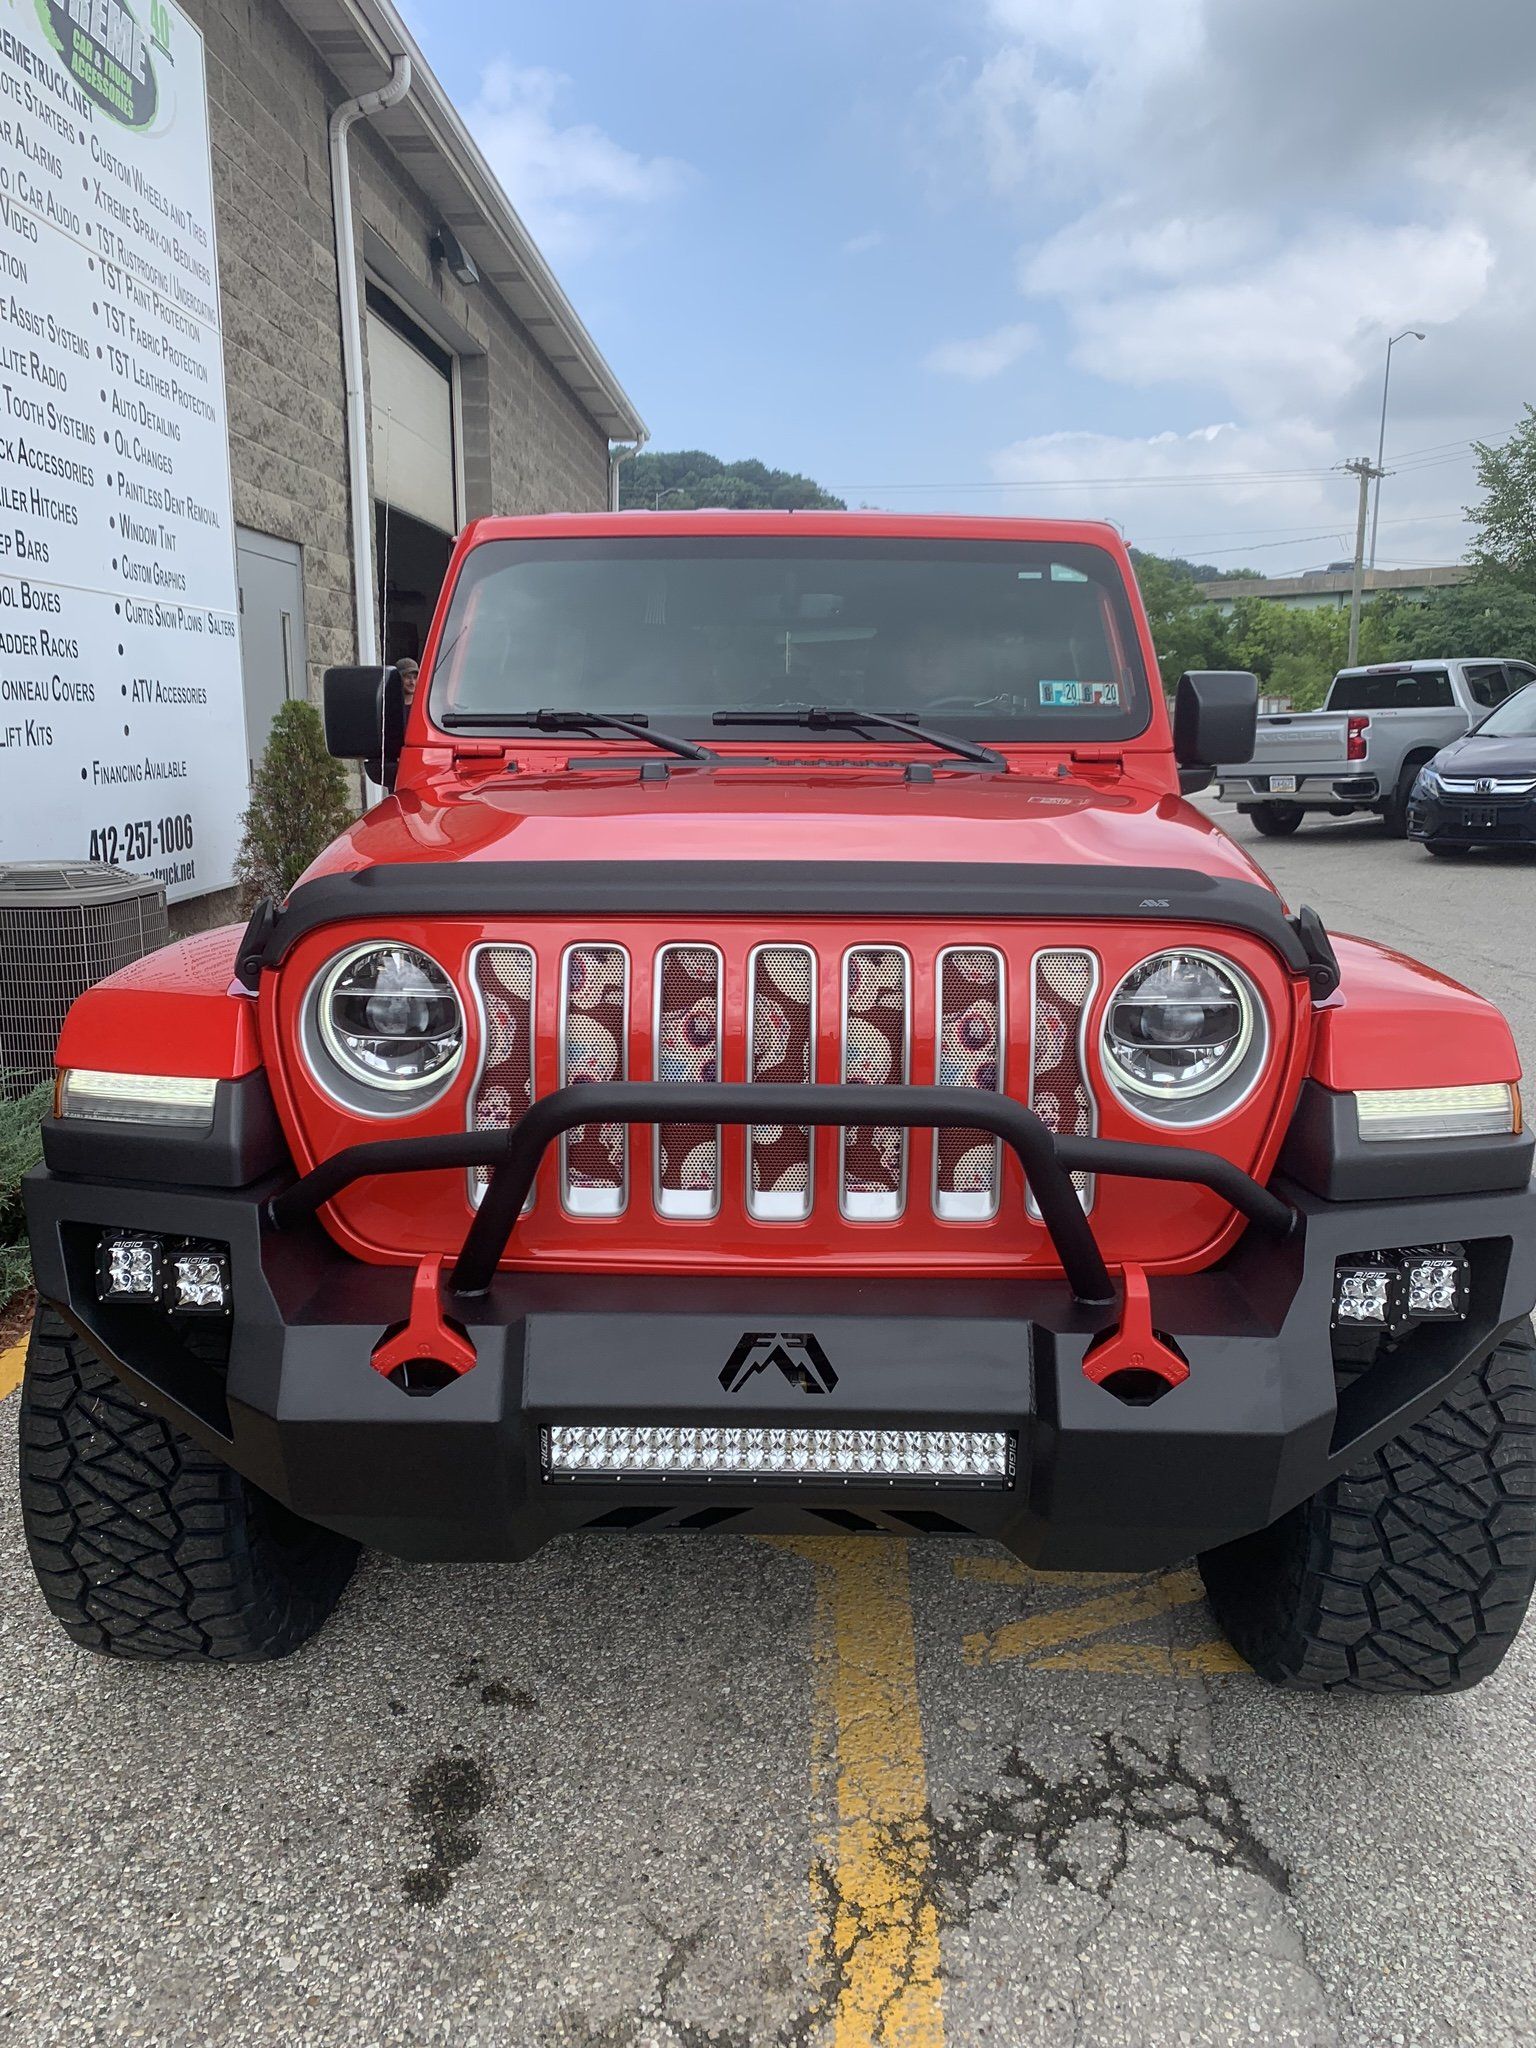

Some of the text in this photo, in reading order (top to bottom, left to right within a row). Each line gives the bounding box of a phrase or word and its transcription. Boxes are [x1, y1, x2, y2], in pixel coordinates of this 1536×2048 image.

[71, 51, 134, 120] ACCESSORIES
[72, 28, 93, 63] CAR
[103, 54, 133, 98] TRUCK
[0, 71, 75, 145] OTE STARTERS
[15, 122, 63, 180] ALARMS
[18, 170, 44, 213] CAR
[46, 190, 80, 236] AUDIO
[91, 134, 208, 248] CUSTOM WHEELS AND TIRES
[0, 197, 38, 244] VIDEO
[93, 177, 211, 287] XTREME SPRAY-ON BEDLINERS
[0, 251, 28, 285] TION
[96, 222, 115, 258] TST
[117, 236, 168, 293] RUSTPROOFING
[99, 256, 200, 343] TST PAINT PROTECTION
[10, 295, 45, 339] ASSIST
[47, 314, 90, 360] SYSTEMS
[102, 301, 208, 384] TST FABRIC PROTECTION
[0, 346, 67, 392] LITE RADIO
[106, 344, 216, 423] TST LEATHER PROTECTION
[2, 383, 96, 446] TOOTH SYSTEMS
[112, 388, 181, 442] AUTO DETAILING
[18, 437, 95, 488] ACCESSORIES
[114, 429, 173, 476] OIL CHANGES
[0, 486, 79, 526] ILER HITCHES
[117, 470, 221, 529] PAINTLESS DENT REMOVAL
[15, 529, 50, 564] BARS
[119, 512, 176, 552] WINDOW TINT
[122, 554, 187, 592] CUSTOM GRAPHICS
[0, 581, 61, 614] OL BOXES
[125, 598, 236, 638] CURTIS SNOW PLOWS SALTERS
[39, 629, 80, 660] RACKS
[1, 674, 96, 703] ONNEAU COVERS
[131, 677, 208, 704] ATV ACCESSORIES
[1065, 683, 1077, 701] 20
[1105, 684, 1117, 701] 20
[0, 718, 53, 748] IFT KITS
[92, 756, 188, 786] FINANCING AVAILABLE
[89, 813, 194, 866] 412-257-1006
[112, 1240, 144, 1248] RIGID
[178, 1256, 210, 1264] RIGID
[1353, 1271, 1387, 1279] RIGID
[540, 1428, 548, 1468] RIGID
[1008, 1437, 1017, 1476] RIGID
